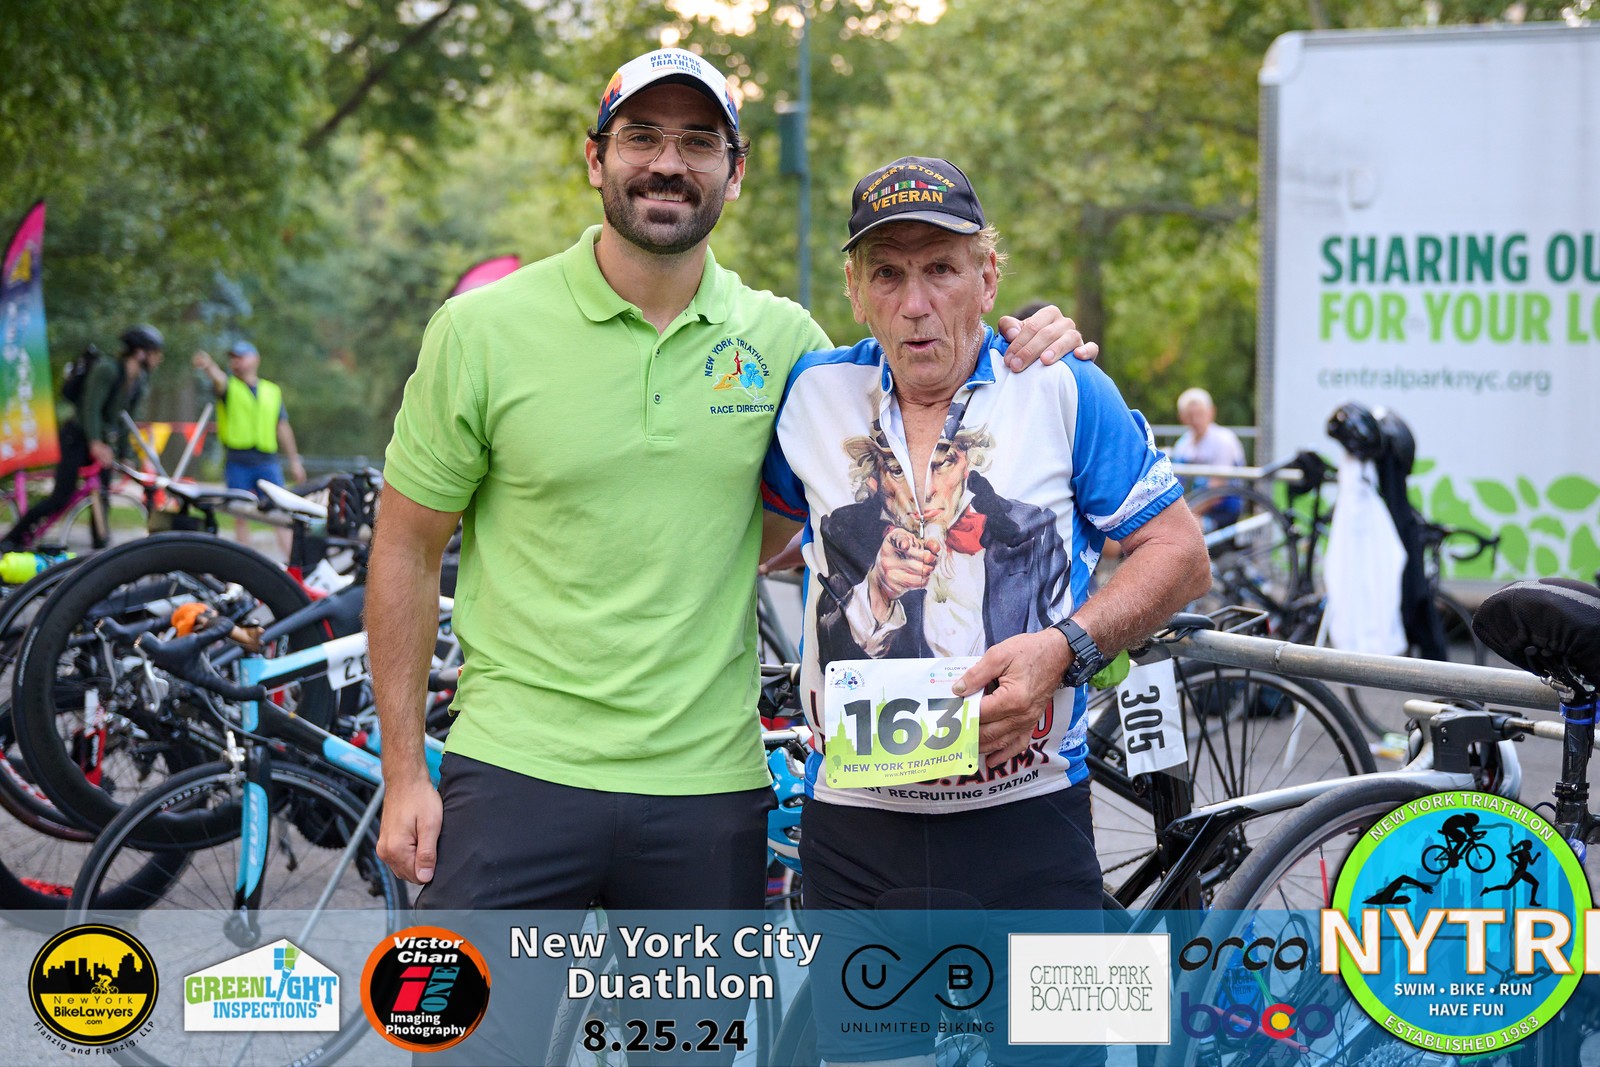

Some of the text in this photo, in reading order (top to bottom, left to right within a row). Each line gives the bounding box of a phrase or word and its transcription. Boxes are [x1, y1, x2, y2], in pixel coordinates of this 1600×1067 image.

[650, 54, 701, 68] NEW YORK
[651, 59, 702, 75] TRIATHLON
[861, 164, 956, 201] DESERT STORM
[872, 190, 943, 213] VETERAN
[1320, 233, 1529, 284] SHARING
[1319, 292, 1407, 342] FOR
[1423, 292, 1551, 343] YOUR
[704, 337, 770, 377] NEW YORK TRIATHLON
[1317, 365, 1553, 395] centralparknyc.org
[710, 404, 775, 414] RACE DIRECTOR
[843, 697, 965, 756] 163
[1121, 685, 1166, 755] 305
[843, 751, 963, 774] NEW YORK TRIATHLON
[884, 768, 927, 778] www.NYTRI.org
[889, 788, 984, 801] RECRUITING
[988, 769, 1039, 795] STATION
